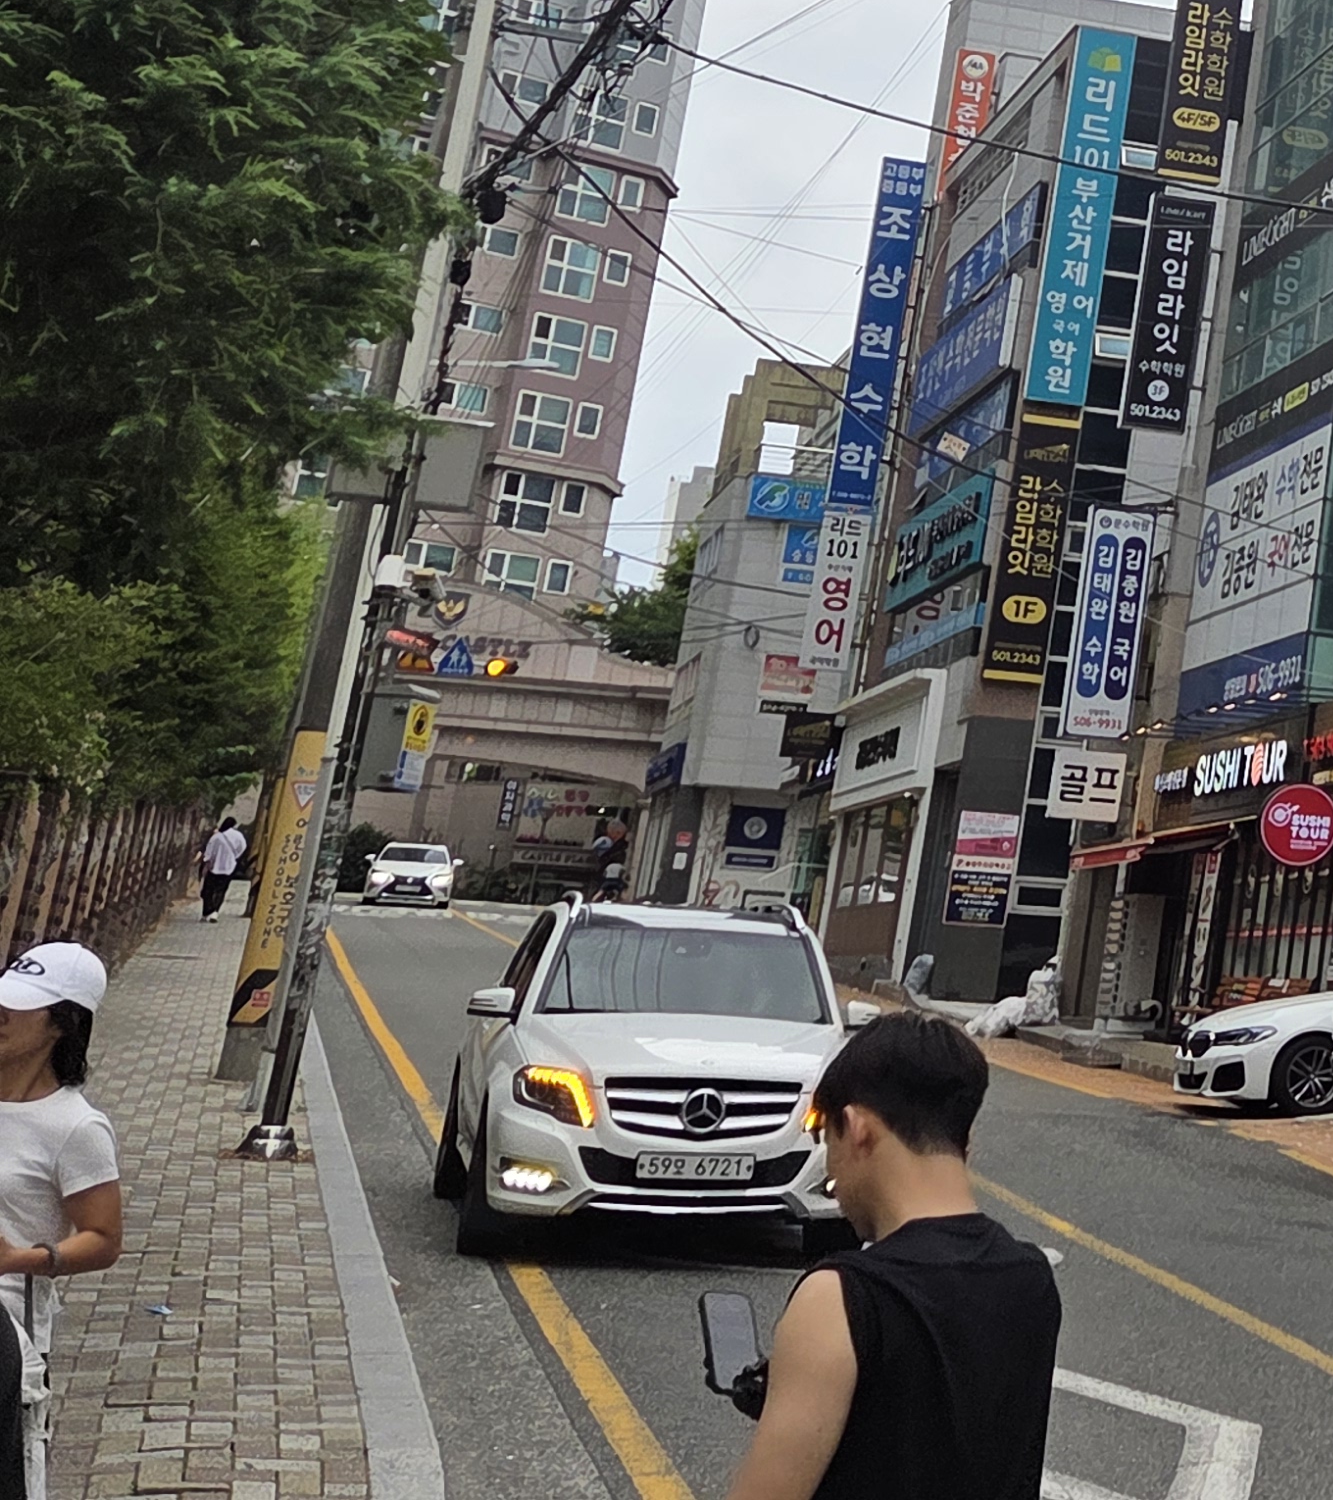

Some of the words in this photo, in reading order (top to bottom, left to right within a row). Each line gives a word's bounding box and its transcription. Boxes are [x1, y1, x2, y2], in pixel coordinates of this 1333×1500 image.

[1178, 2, 1210, 97] 라임라잇
[1203, 7, 1233, 101] 수학학원
[1077, 77, 1116, 142] 리드
[1176, 113, 1217, 127] 4F/5F
[1074, 146, 1108, 170] 101
[1061, 177, 1099, 288] 부산거제
[1152, 230, 1194, 354] 라임라잇
[1045, 338, 1078, 394] 학원
[1138, 360, 1185, 378] 수학학원
[1130, 404, 1181, 421] 501.2343
[826, 538, 859, 559] 101
[830, 517, 862, 537] 리드
[1007, 475, 1042, 576] 라임라잇
[1089, 545, 1114, 621] 김태완
[1119, 549, 1142, 623] 김종원
[815, 577, 852, 653] 영어
[1012, 600, 1036, 618] 1F
[1081, 636, 1102, 685] 수학
[1110, 638, 1131, 687] 국어
[1060, 764, 1120, 804] 골프
[1194, 748, 1239, 797] SUSHI
[1243, 740, 1287, 786] TOUR
[1291, 814, 1331, 827] SUSHI
[1291, 826, 1329, 840] TOUR
[694, 1157, 743, 1177] 6721
